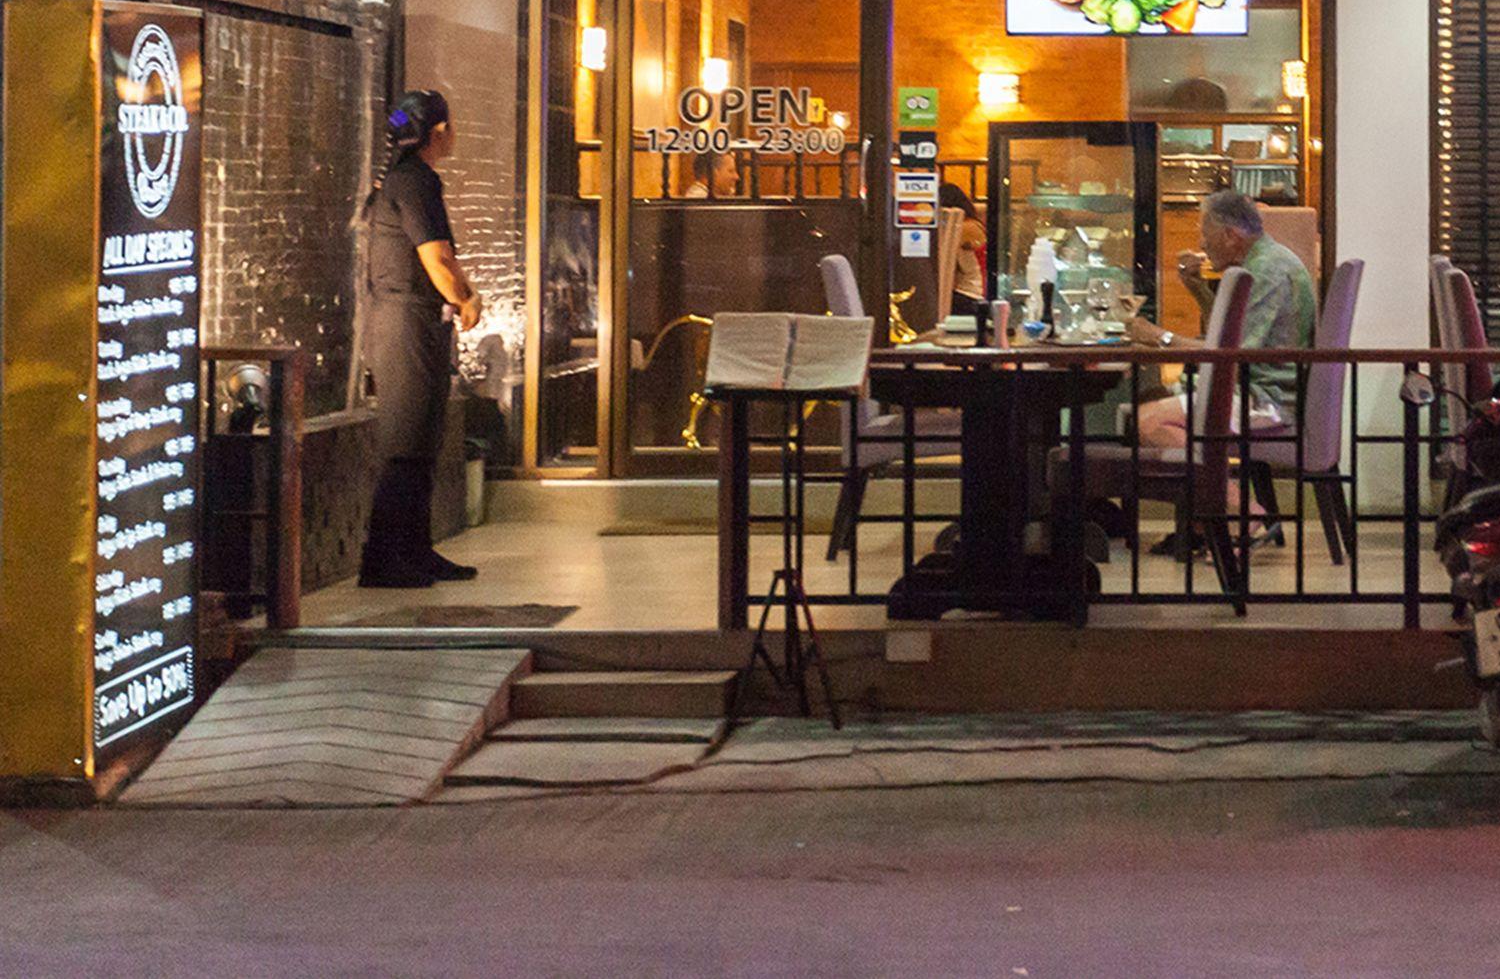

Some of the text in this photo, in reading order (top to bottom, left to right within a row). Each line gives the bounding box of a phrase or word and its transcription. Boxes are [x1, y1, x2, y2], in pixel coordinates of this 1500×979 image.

[680, 86, 812, 125] OPEN
[646, 128, 730, 154] 12:00
[757, 127, 847, 154] 23:00
